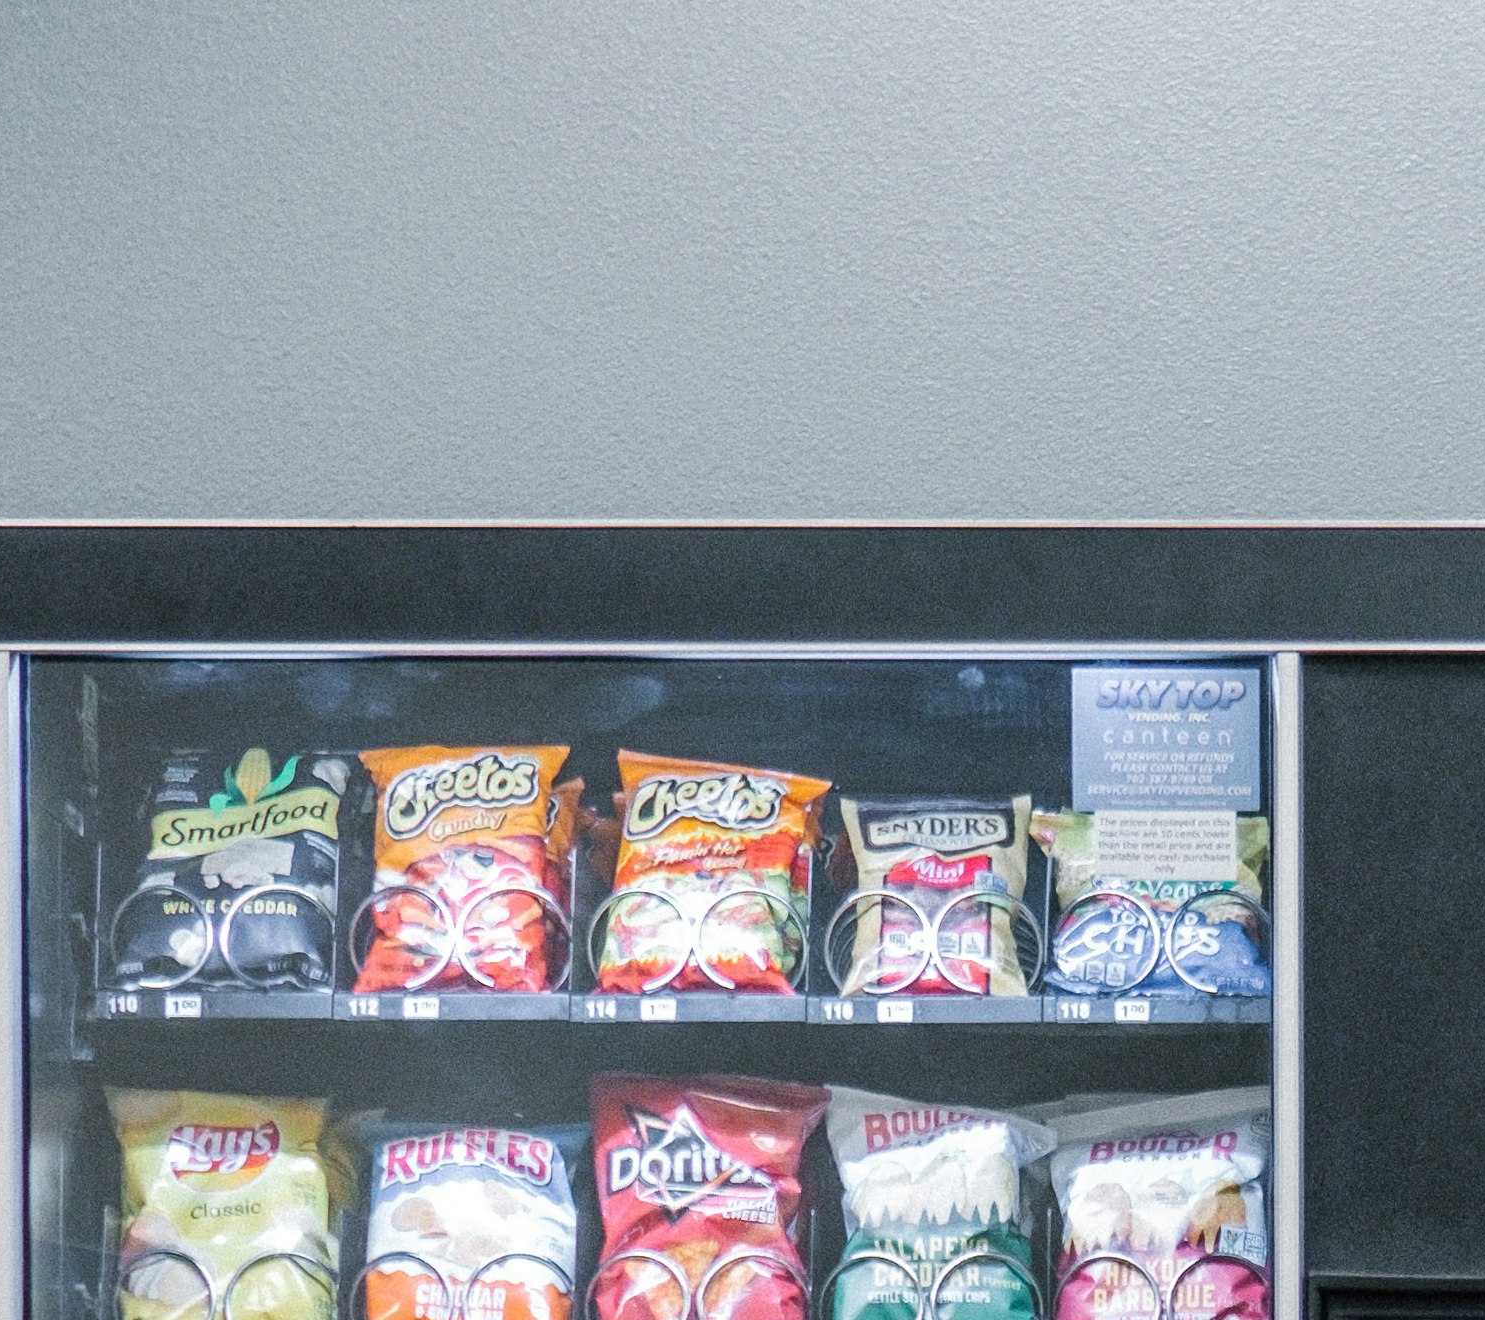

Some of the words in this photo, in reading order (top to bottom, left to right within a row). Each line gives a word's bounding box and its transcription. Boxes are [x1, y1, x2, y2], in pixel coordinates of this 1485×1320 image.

[1098, 679, 1172, 709] SKY
[1175, 679, 1246, 710] TOP
[1102, 727, 1232, 746] canteen
[387, 754, 539, 831] Cheetos
[627, 774, 784, 834] Cheetos
[160, 799, 330, 848] Smartfood
[875, 816, 1000, 837] SNYDER'S
[913, 861, 966, 879] Mini
[173, 1122, 276, 1173] Lay's
[382, 1129, 554, 1188] RUFFLES
[1089, 1131, 1239, 1163] BOULDER
[190, 1201, 262, 1221] Classic
